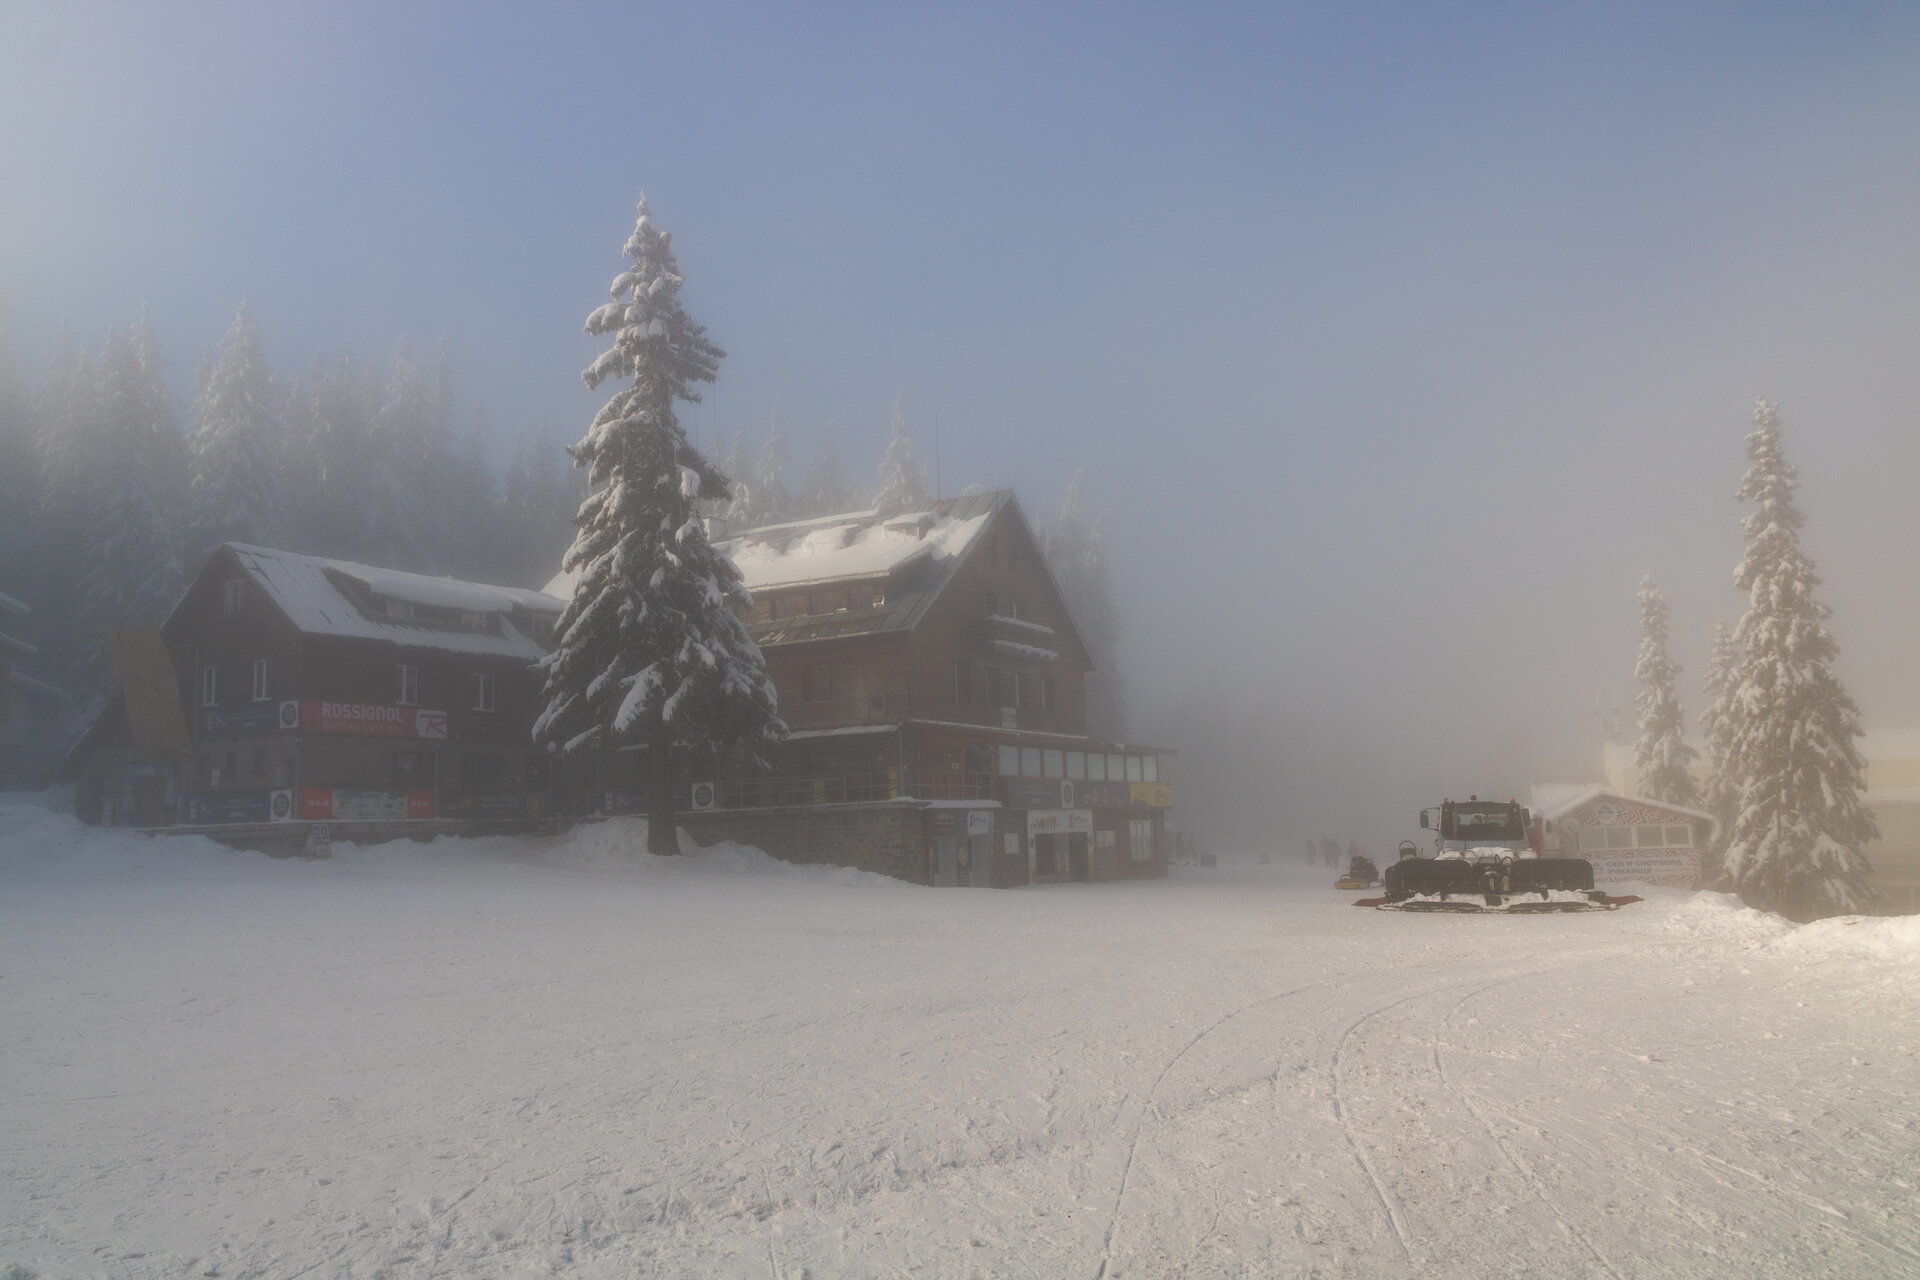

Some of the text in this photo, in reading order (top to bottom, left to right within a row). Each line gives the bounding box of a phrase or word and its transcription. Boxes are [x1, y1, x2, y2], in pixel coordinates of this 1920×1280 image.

[322, 703, 403, 722] ROSSIGNOL
[1635, 859, 1683, 867] СНОУБОРД
[1608, 867, 1652, 876] УЧИЛИЩЕ
